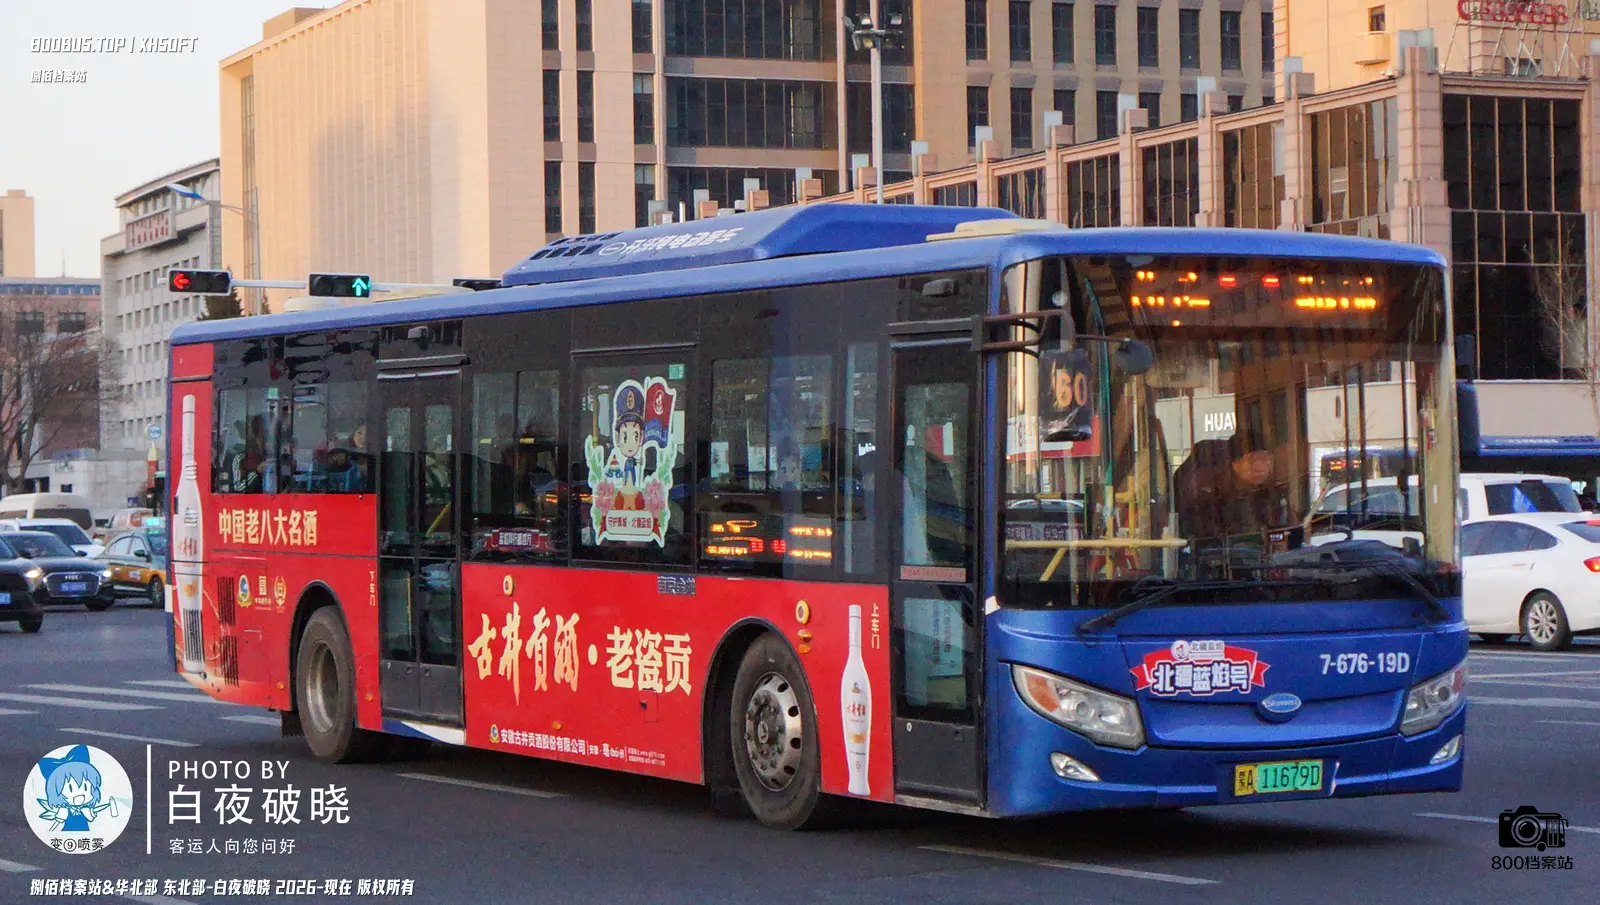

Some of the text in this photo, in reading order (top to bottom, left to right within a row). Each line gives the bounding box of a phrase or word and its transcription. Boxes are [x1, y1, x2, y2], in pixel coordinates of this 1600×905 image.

[1204, 412, 1236, 432] HUA
[218, 508, 318, 546] 中国老八大名酒
[1153, 661, 1249, 692] 北疆蓝焰号
[1320, 652, 1410, 675] 7-676-19D
[500, 729, 586, 755] 安徽古井贡酒股份有限公司
